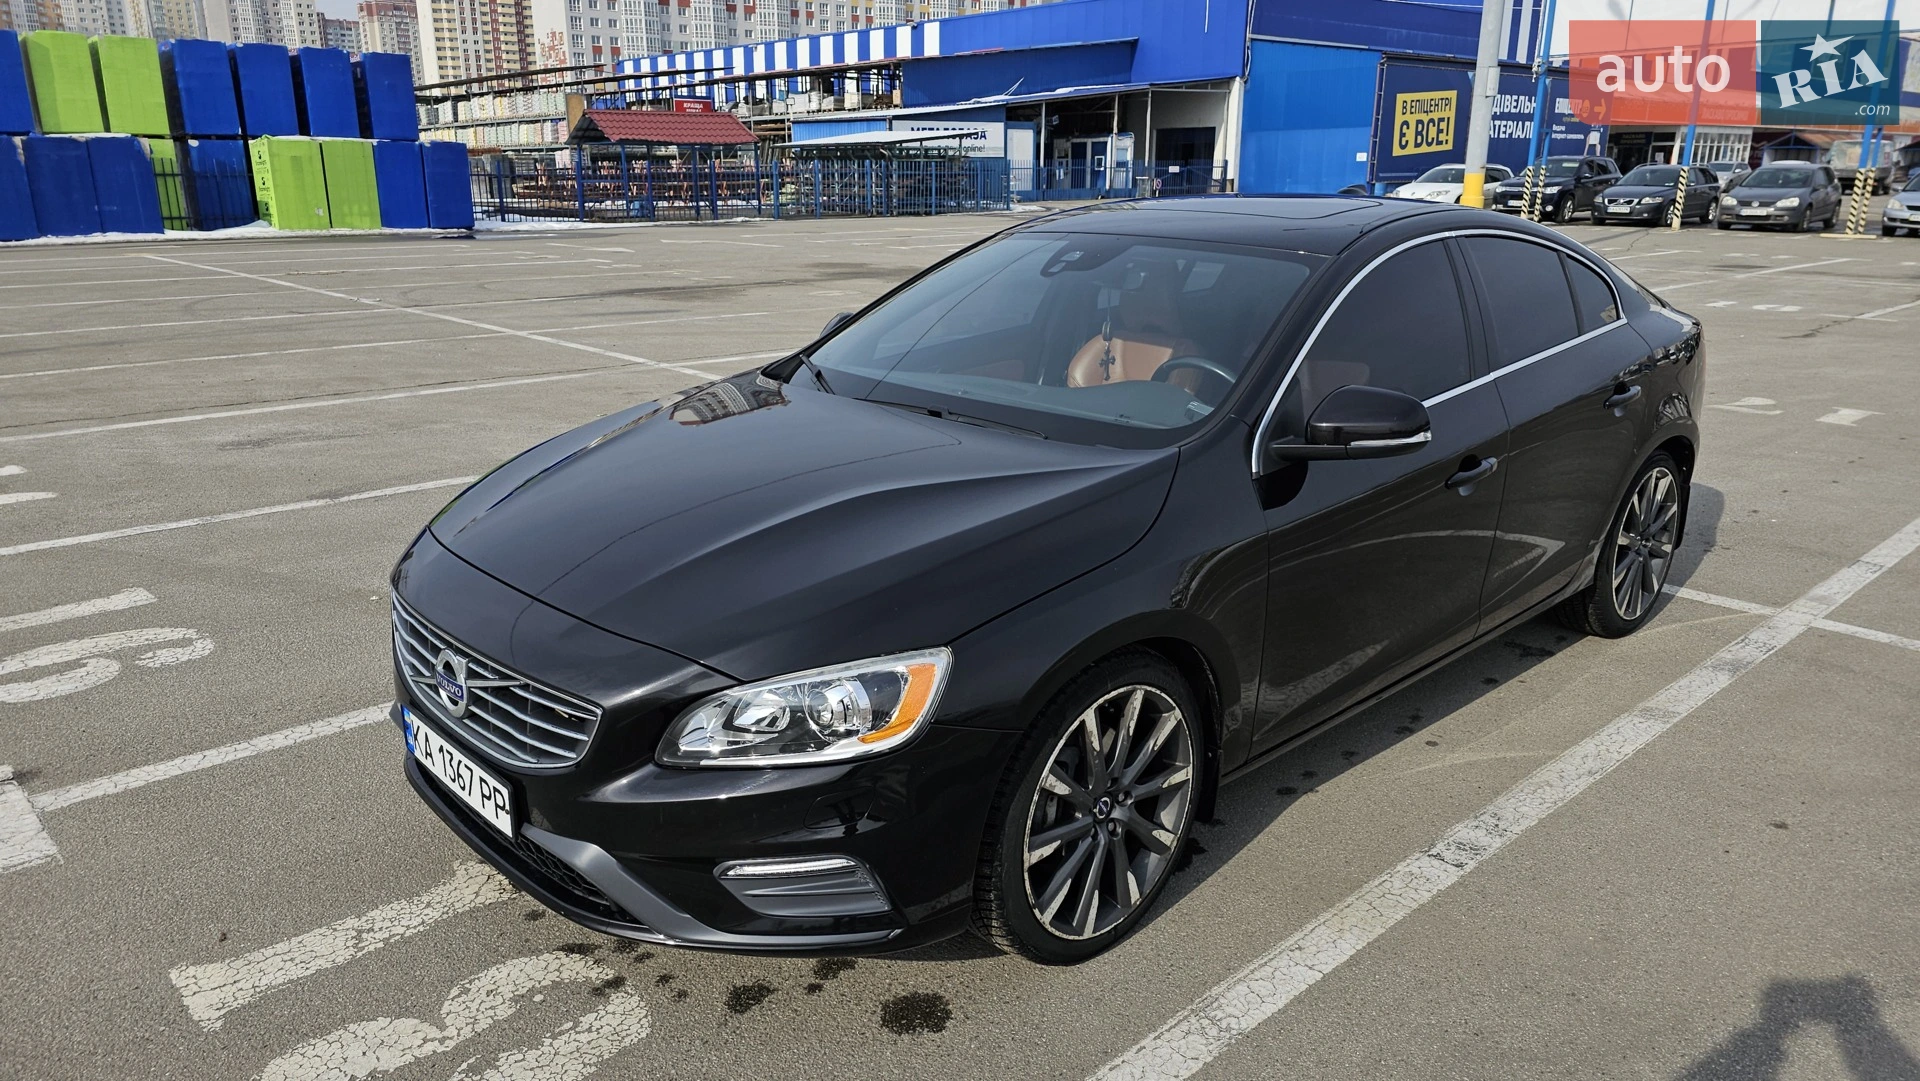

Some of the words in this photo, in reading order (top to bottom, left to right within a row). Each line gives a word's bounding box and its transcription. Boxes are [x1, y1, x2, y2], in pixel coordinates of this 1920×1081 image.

[1401, 100, 1408, 115] В
[1410, 97, 1452, 116] ЕПІЦЕНТРІ
[1492, 94, 1537, 115] ДІВЕЛЬН
[1398, 120, 1410, 150] Є
[1413, 117, 1451, 148] ВСЕ!
[1489, 120, 1534, 139] АТЕРІАЛ
[436, 672, 463, 697] VOLVO
[411, 719, 435, 767] KA
[438, 744, 474, 797] 1367
[479, 775, 507, 819] PP
